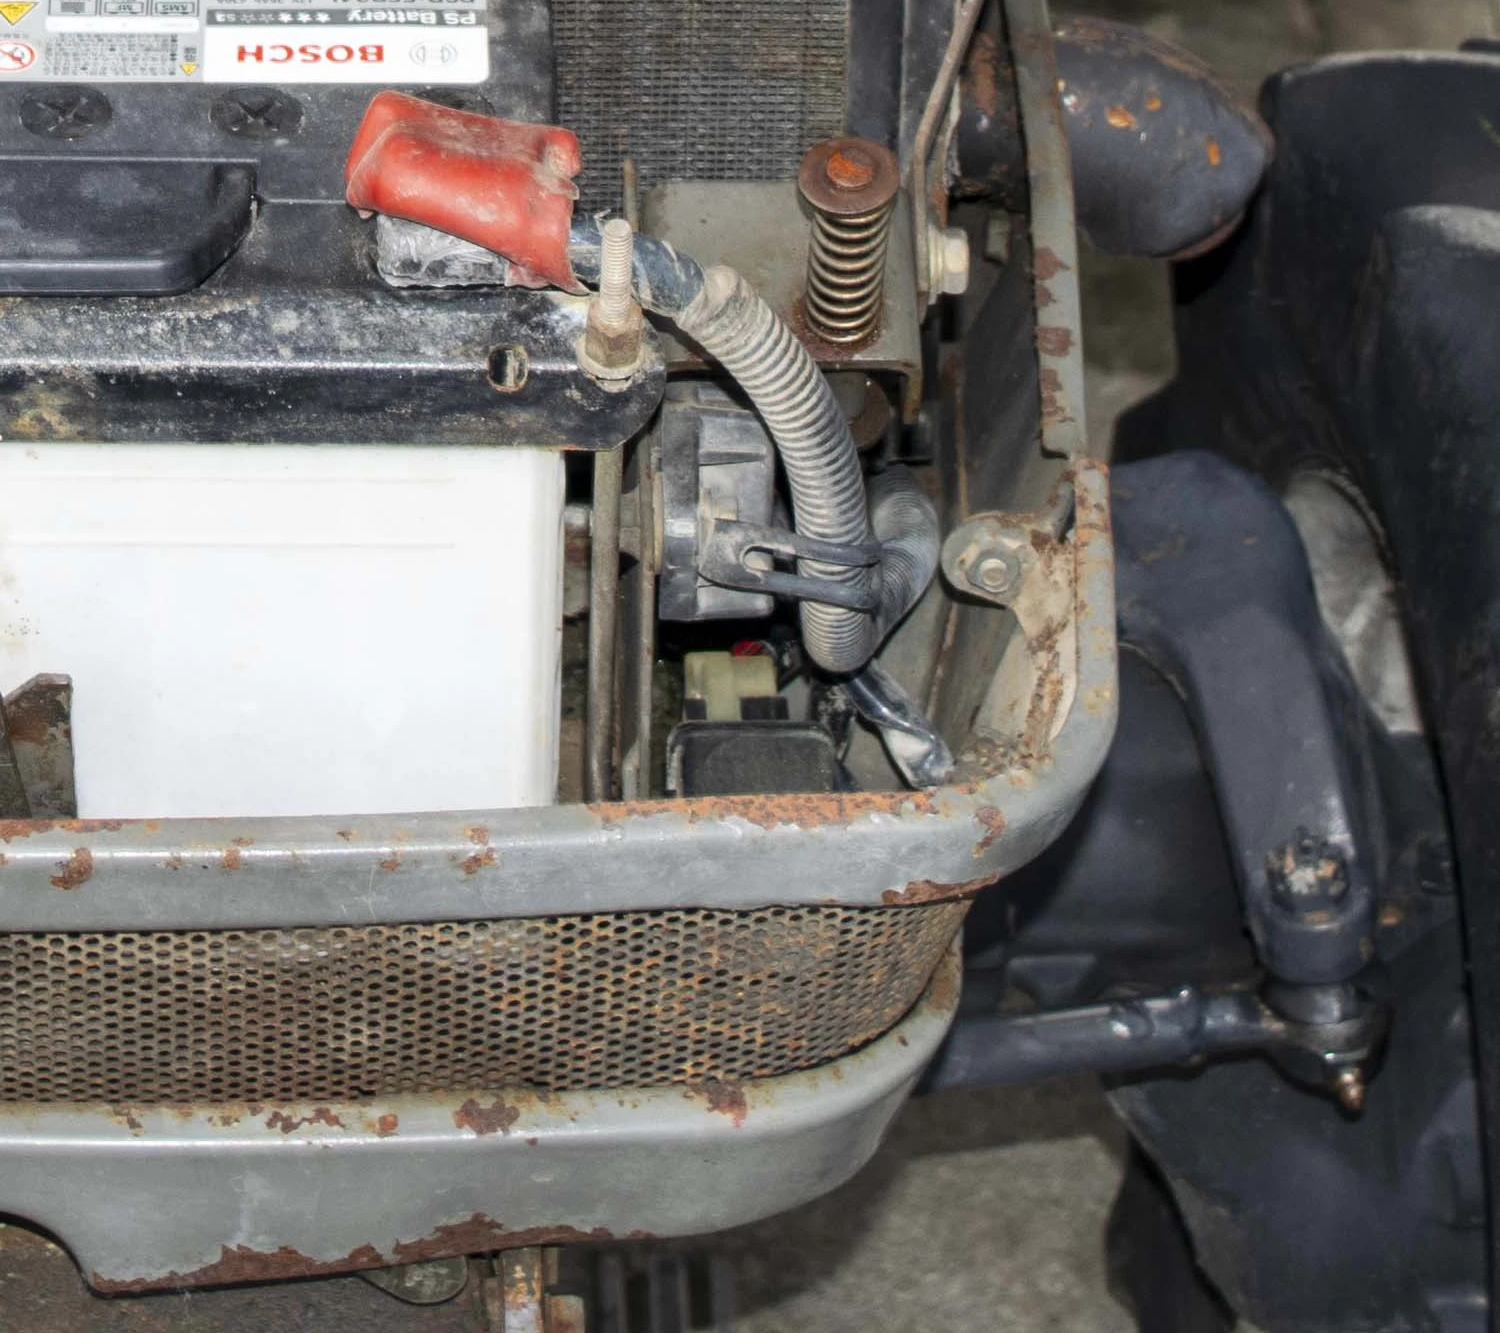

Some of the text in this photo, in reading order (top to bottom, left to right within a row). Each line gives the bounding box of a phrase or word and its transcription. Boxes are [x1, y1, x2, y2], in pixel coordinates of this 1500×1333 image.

[347, 8, 438, 25] Battery
[442, 11, 477, 25] PS
[236, 44, 385, 64] BOSCH
